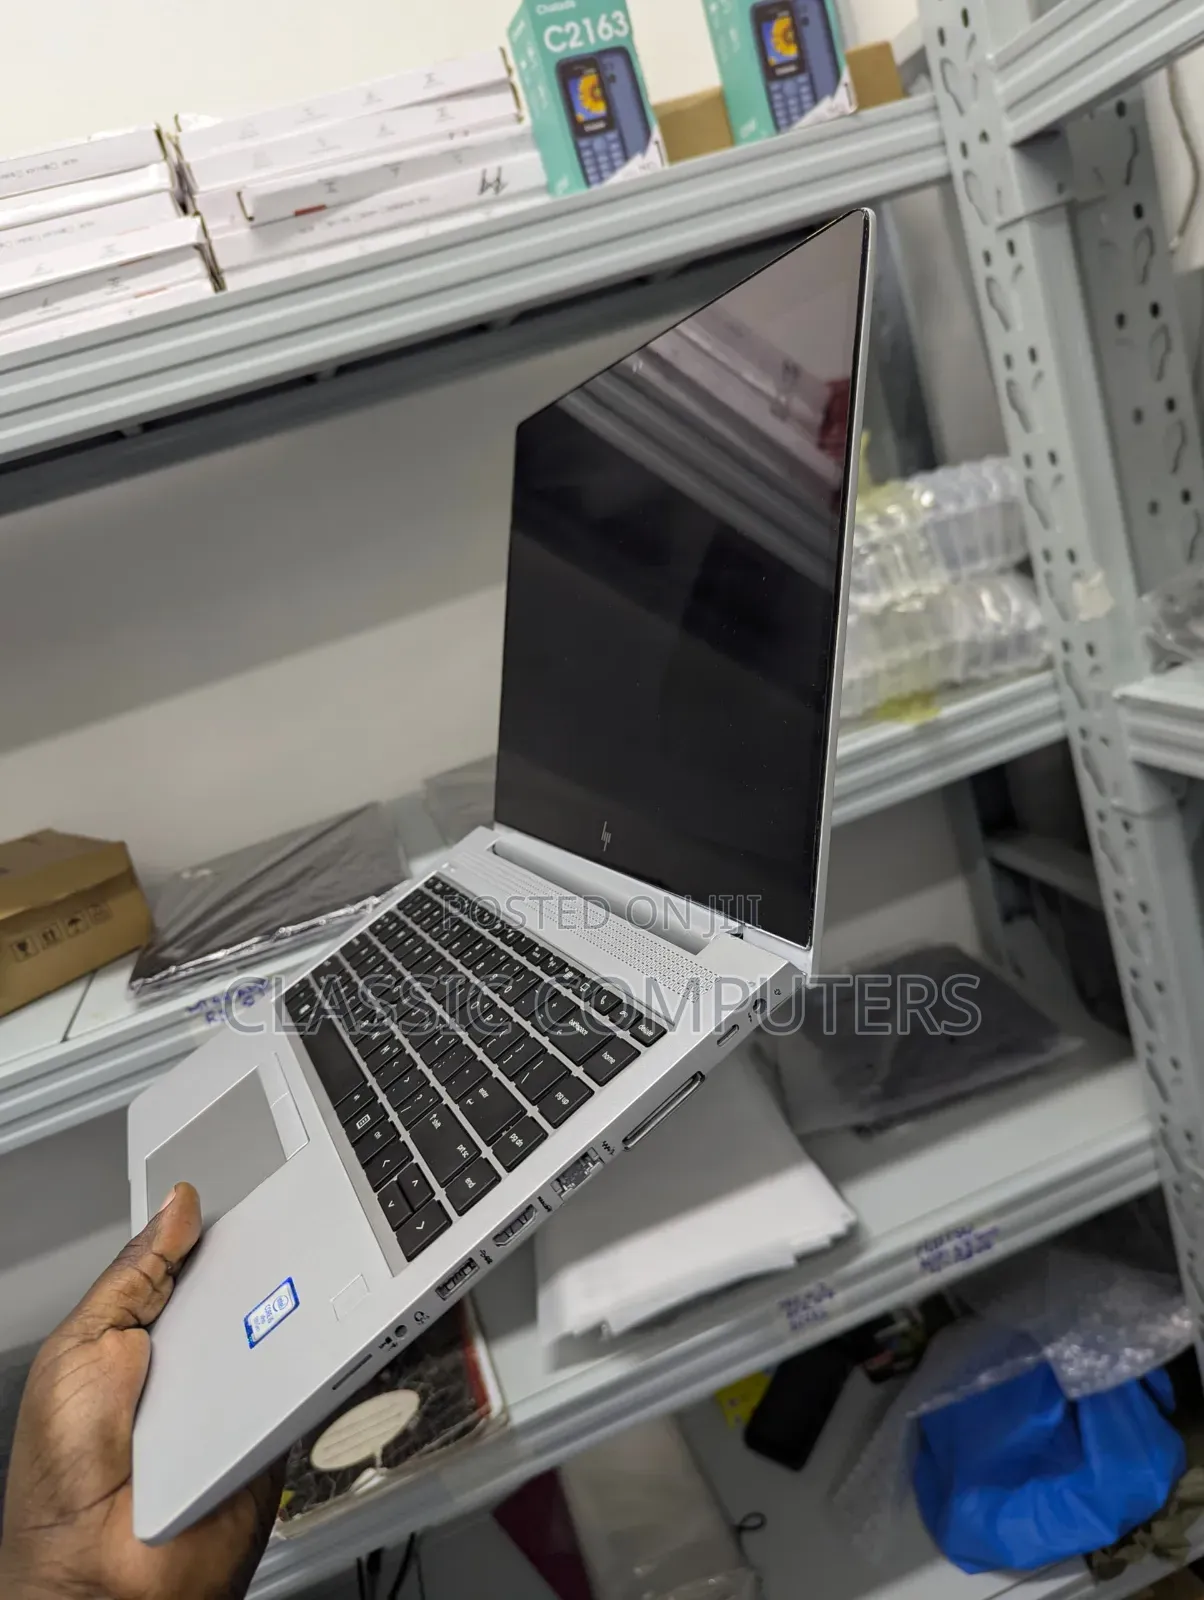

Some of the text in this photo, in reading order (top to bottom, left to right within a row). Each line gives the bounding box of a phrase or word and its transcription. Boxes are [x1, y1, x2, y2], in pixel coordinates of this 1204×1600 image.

[543, 10, 629, 52] C2163
[568, 1018, 589, 1036] backspace
[602, 1051, 616, 1064] home
[479, 1087, 490, 1099] enter
[464, 1177, 477, 1189] end
